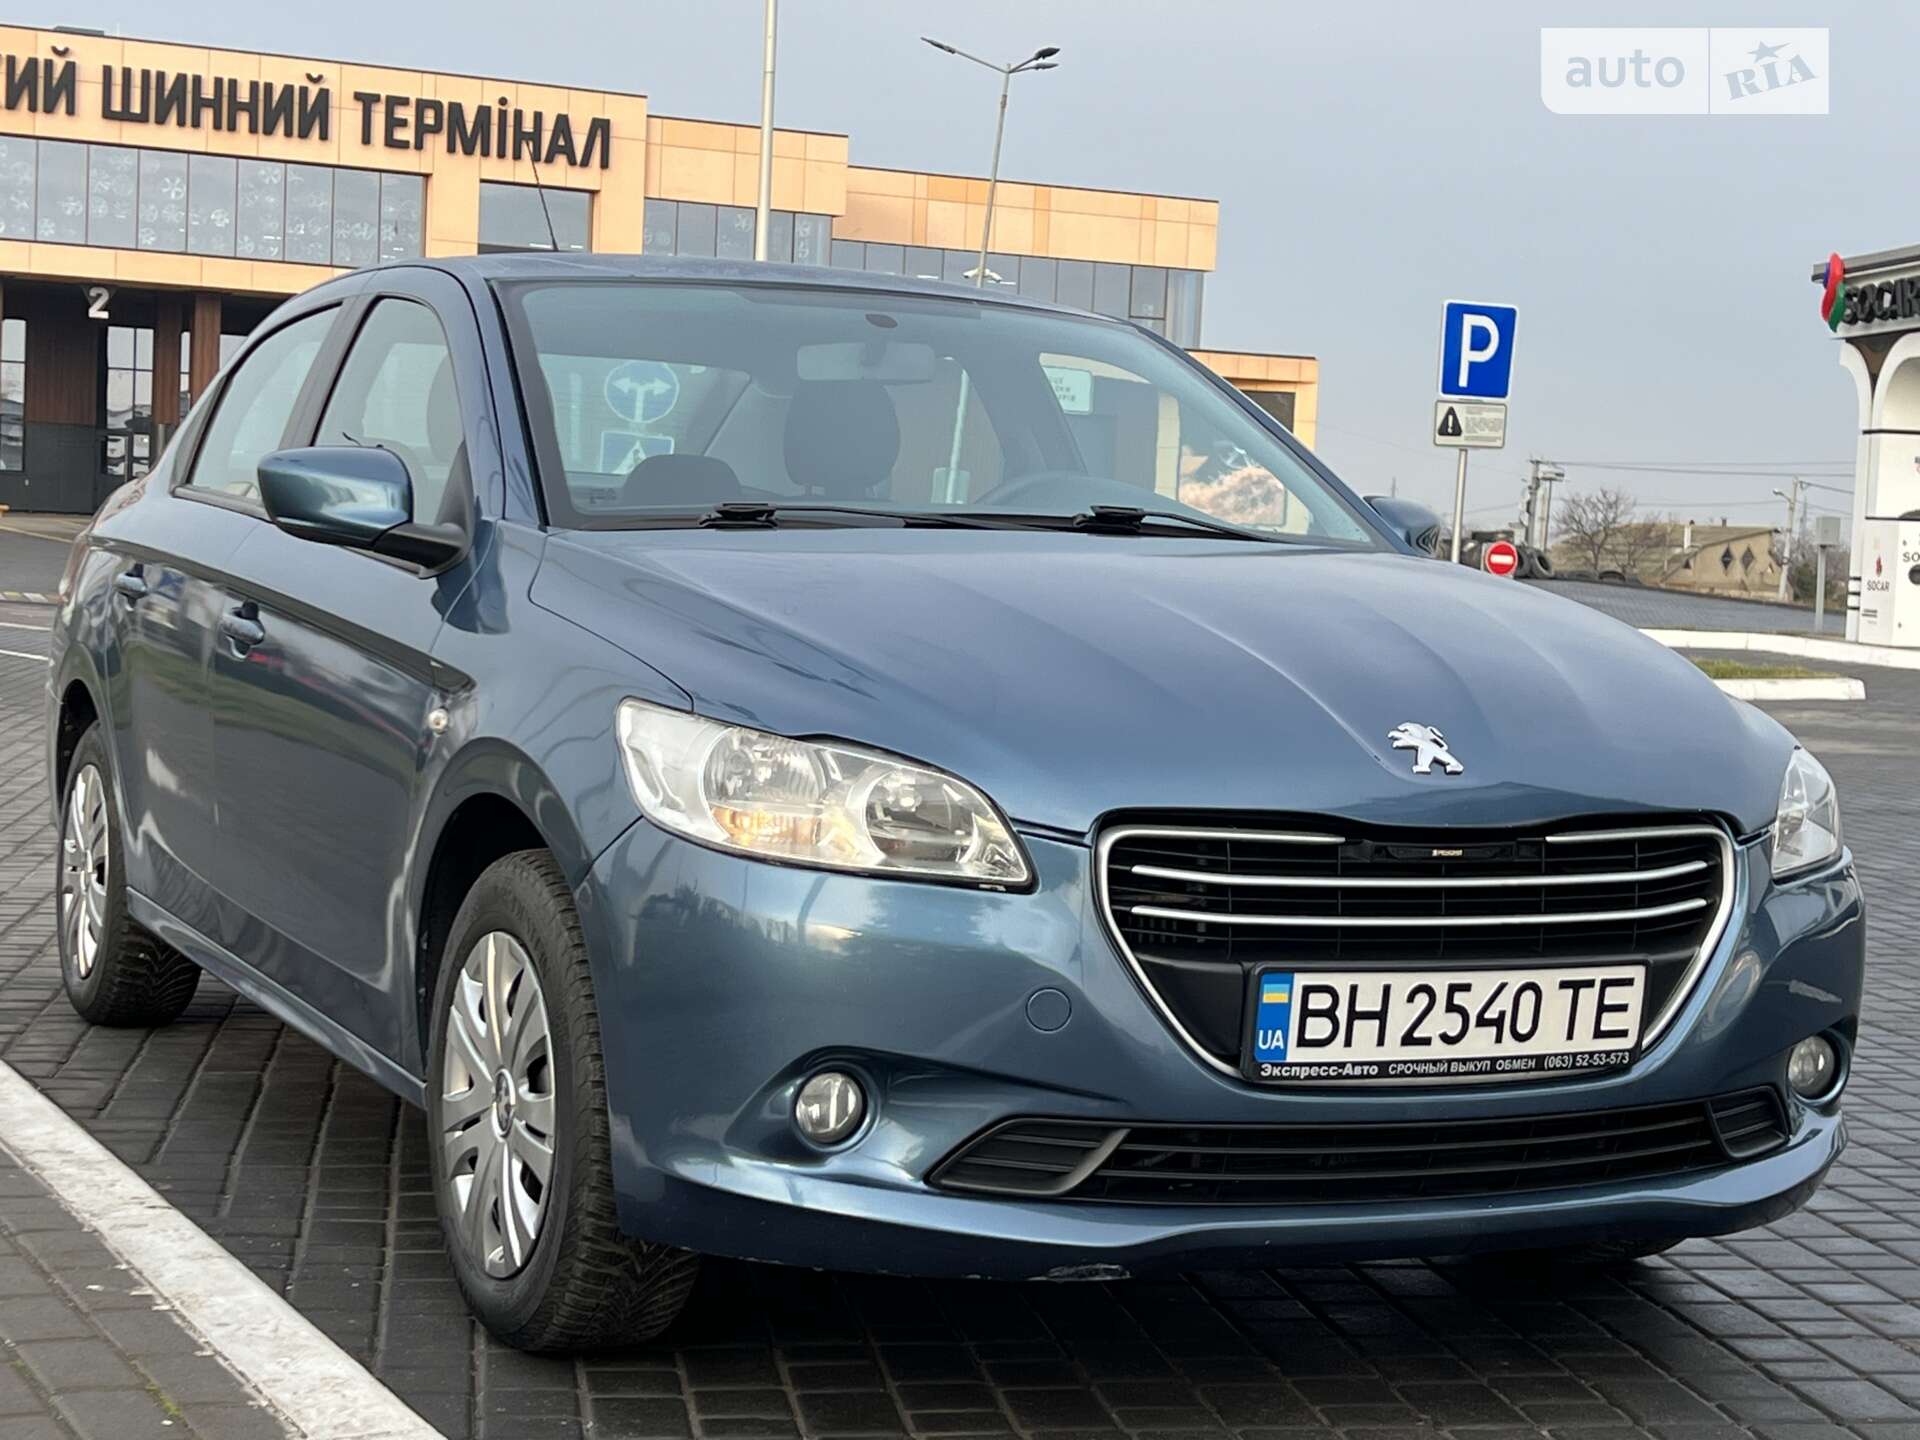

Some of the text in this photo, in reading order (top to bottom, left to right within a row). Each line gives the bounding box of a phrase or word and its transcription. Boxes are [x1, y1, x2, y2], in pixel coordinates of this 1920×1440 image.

[0, 45, 76, 116] ИЙ
[102, 64, 330, 141] ШИННИЙ
[88, 287, 110, 319] 2
[1843, 278, 1920, 325] SOCAR
[1458, 313, 1499, 387] P
[1867, 581, 1890, 591] SOCAR
[1296, 977, 1635, 1048] BH 2540 TE
[1258, 1029, 1284, 1050] UA
[1260, 1052, 1630, 1078] Экспресс-Авто СРОЧНЫЙ ВЫКУП ОБМЕН (063) 52-53-573
